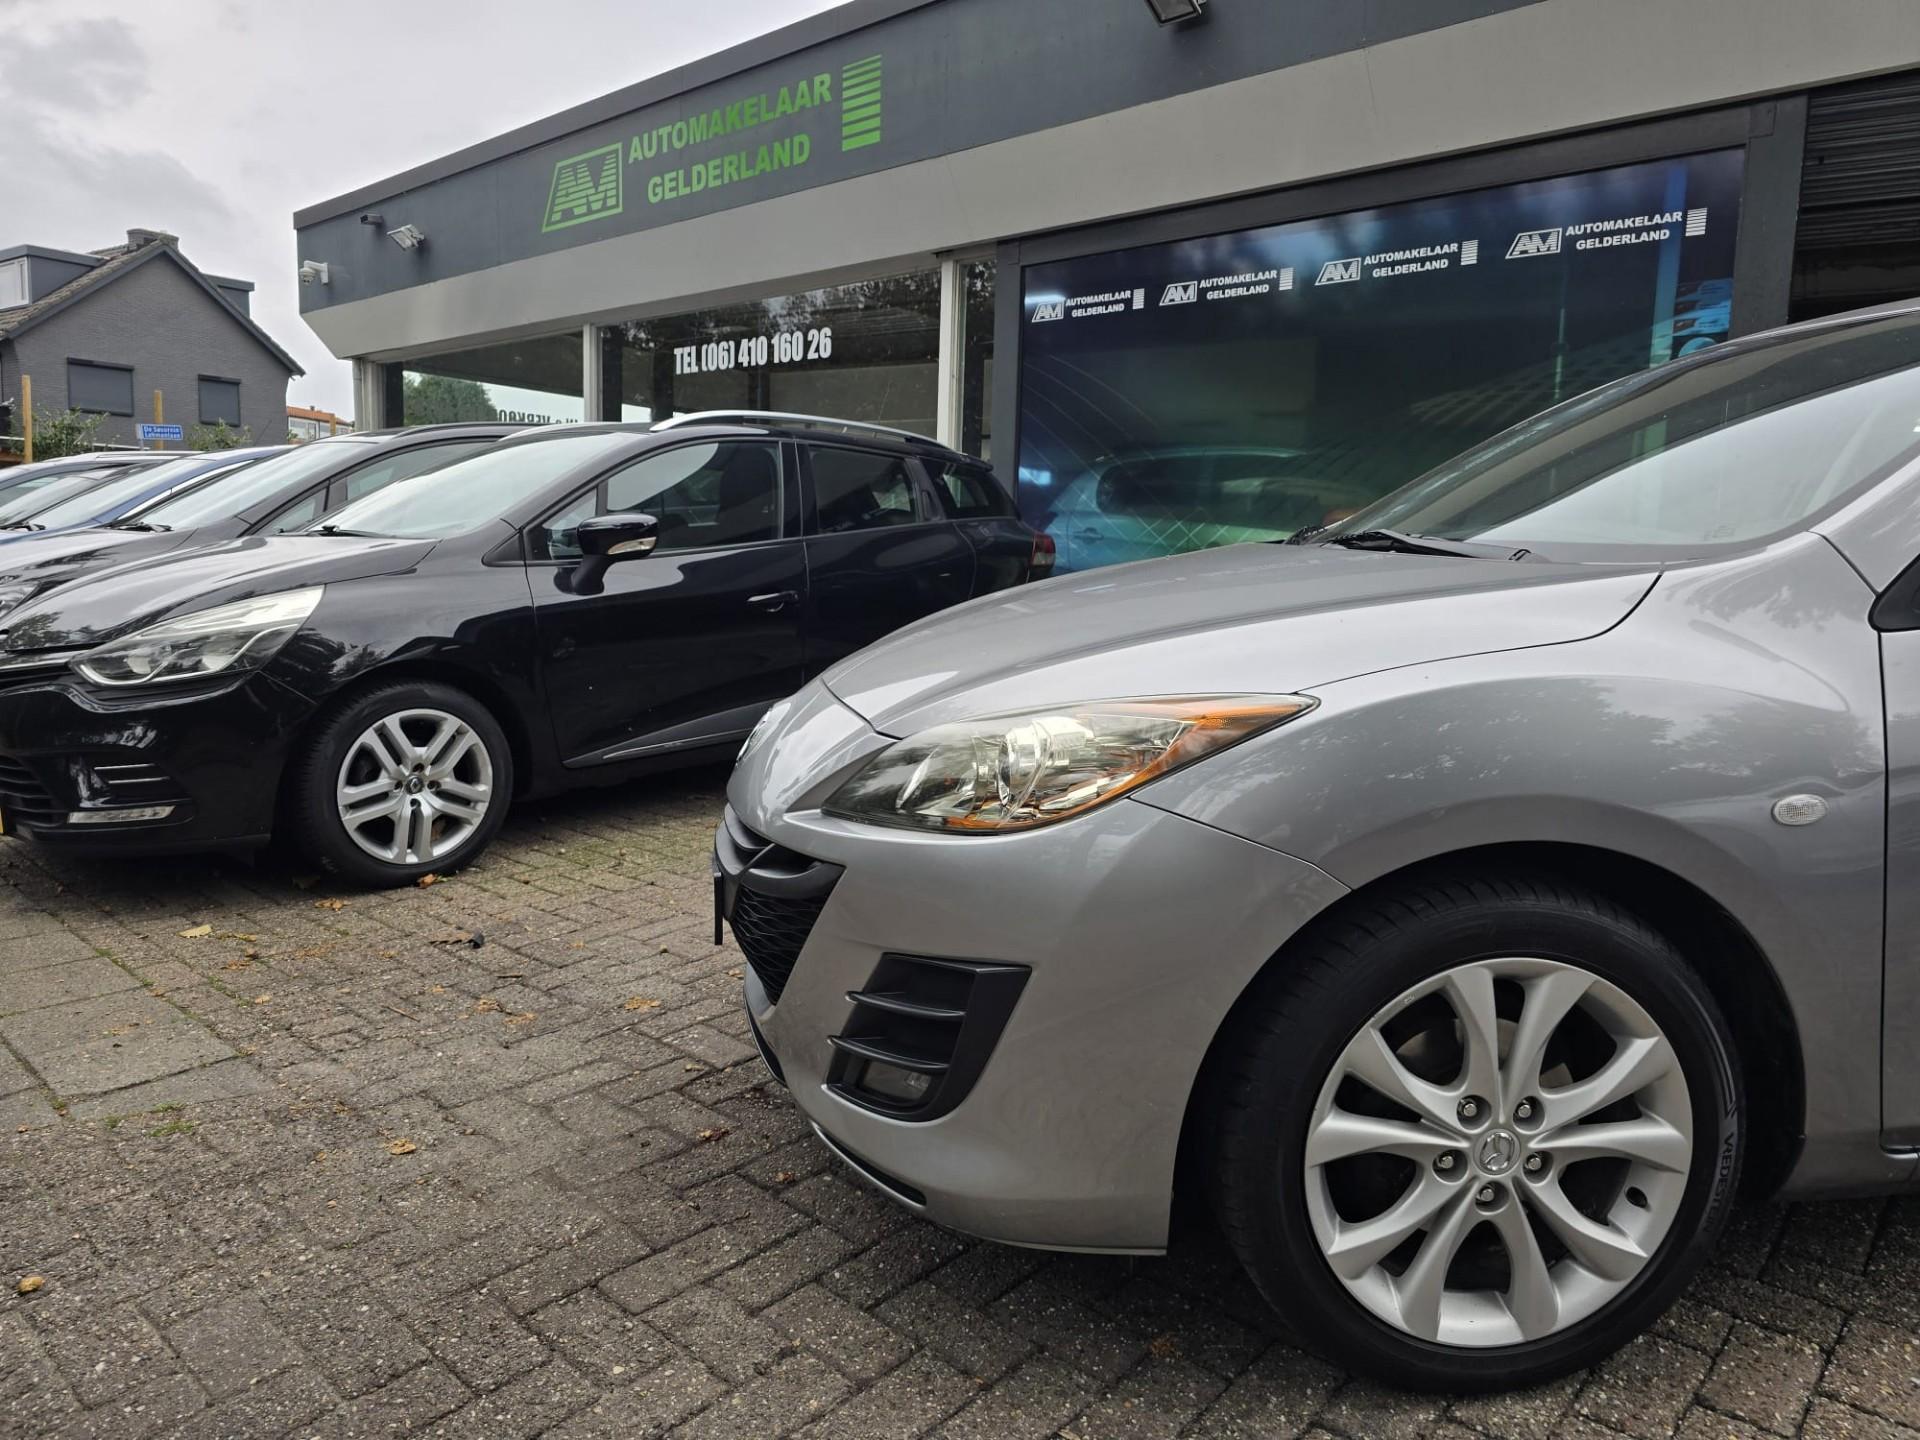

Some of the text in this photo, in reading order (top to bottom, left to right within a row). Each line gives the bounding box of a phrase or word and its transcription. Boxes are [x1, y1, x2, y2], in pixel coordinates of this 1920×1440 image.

[628, 73, 832, 164] AUTOMAKELAAR
[647, 134, 811, 203] GELDERLAND
[551, 152, 617, 222] AM
[1565, 211, 1682, 236] AUTOMAKELAAR
[1512, 231, 1558, 256] AM
[1576, 229, 1670, 250] GELDERLAND
[1364, 243, 1458, 265] AUTOMAKELAAR
[1199, 269, 1277, 288] AUTOMAKELAAR
[1320, 261, 1359, 282] AM
[1372, 259, 1449, 278] GELDERLAND
[1065, 290, 1131, 306] AUTOMAKELAAR
[1164, 284, 1196, 303] AM
[1206, 284, 1269, 300] GELDERLAND
[1035, 303, 1061, 320] AM
[1071, 303, 1124, 318] GELDERLAND
[674, 327, 832, 375] TEL (06) 410 160 26
